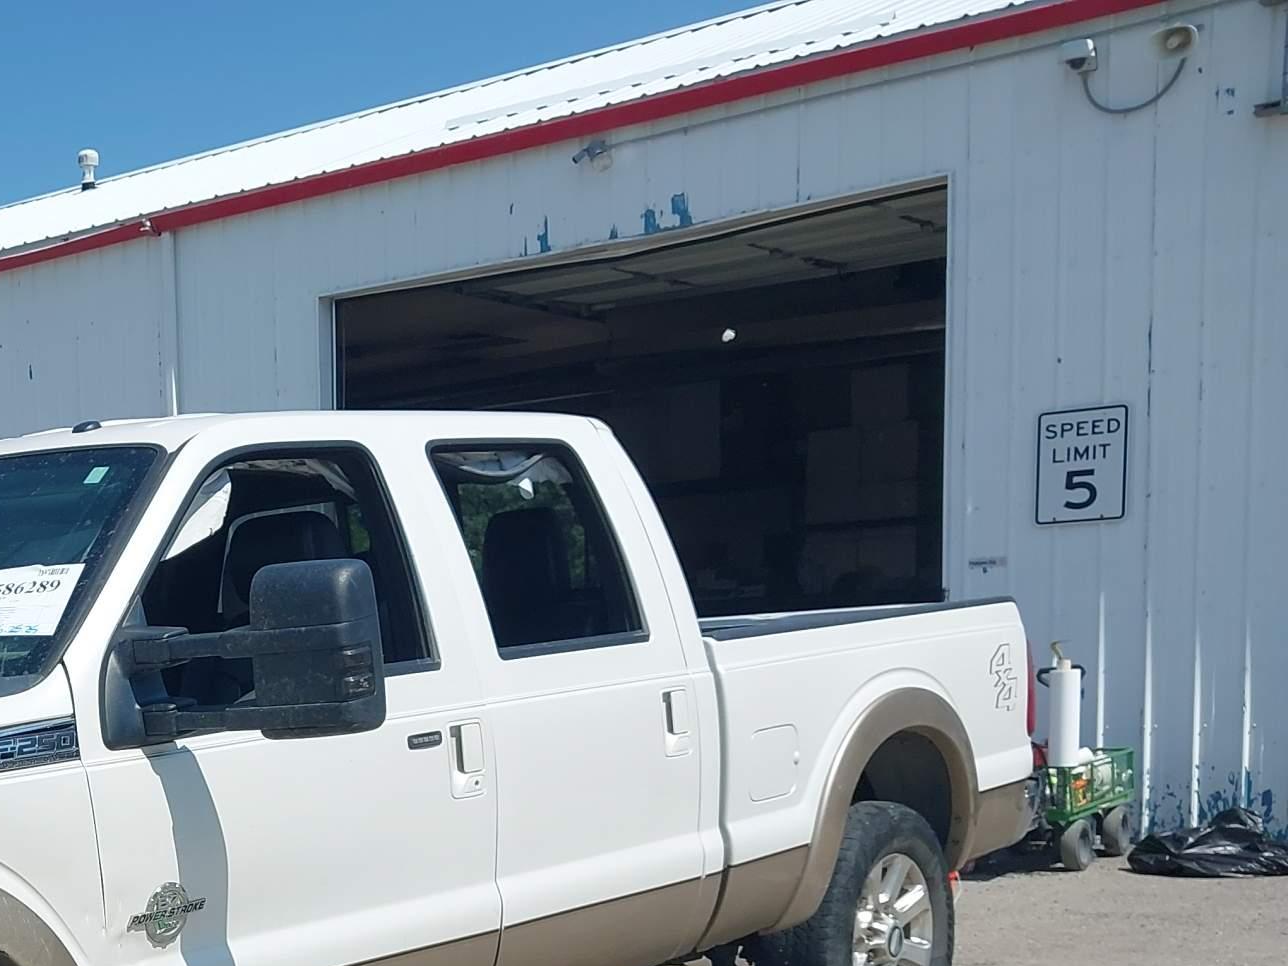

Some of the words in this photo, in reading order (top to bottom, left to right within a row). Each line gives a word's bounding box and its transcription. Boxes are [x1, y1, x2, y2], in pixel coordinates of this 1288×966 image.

[1045, 418, 1121, 440] SPEED
[1052, 443, 1112, 464] LIMIT
[1063, 468, 1098, 510] 5
[167, 900, 206, 917] STROKE
